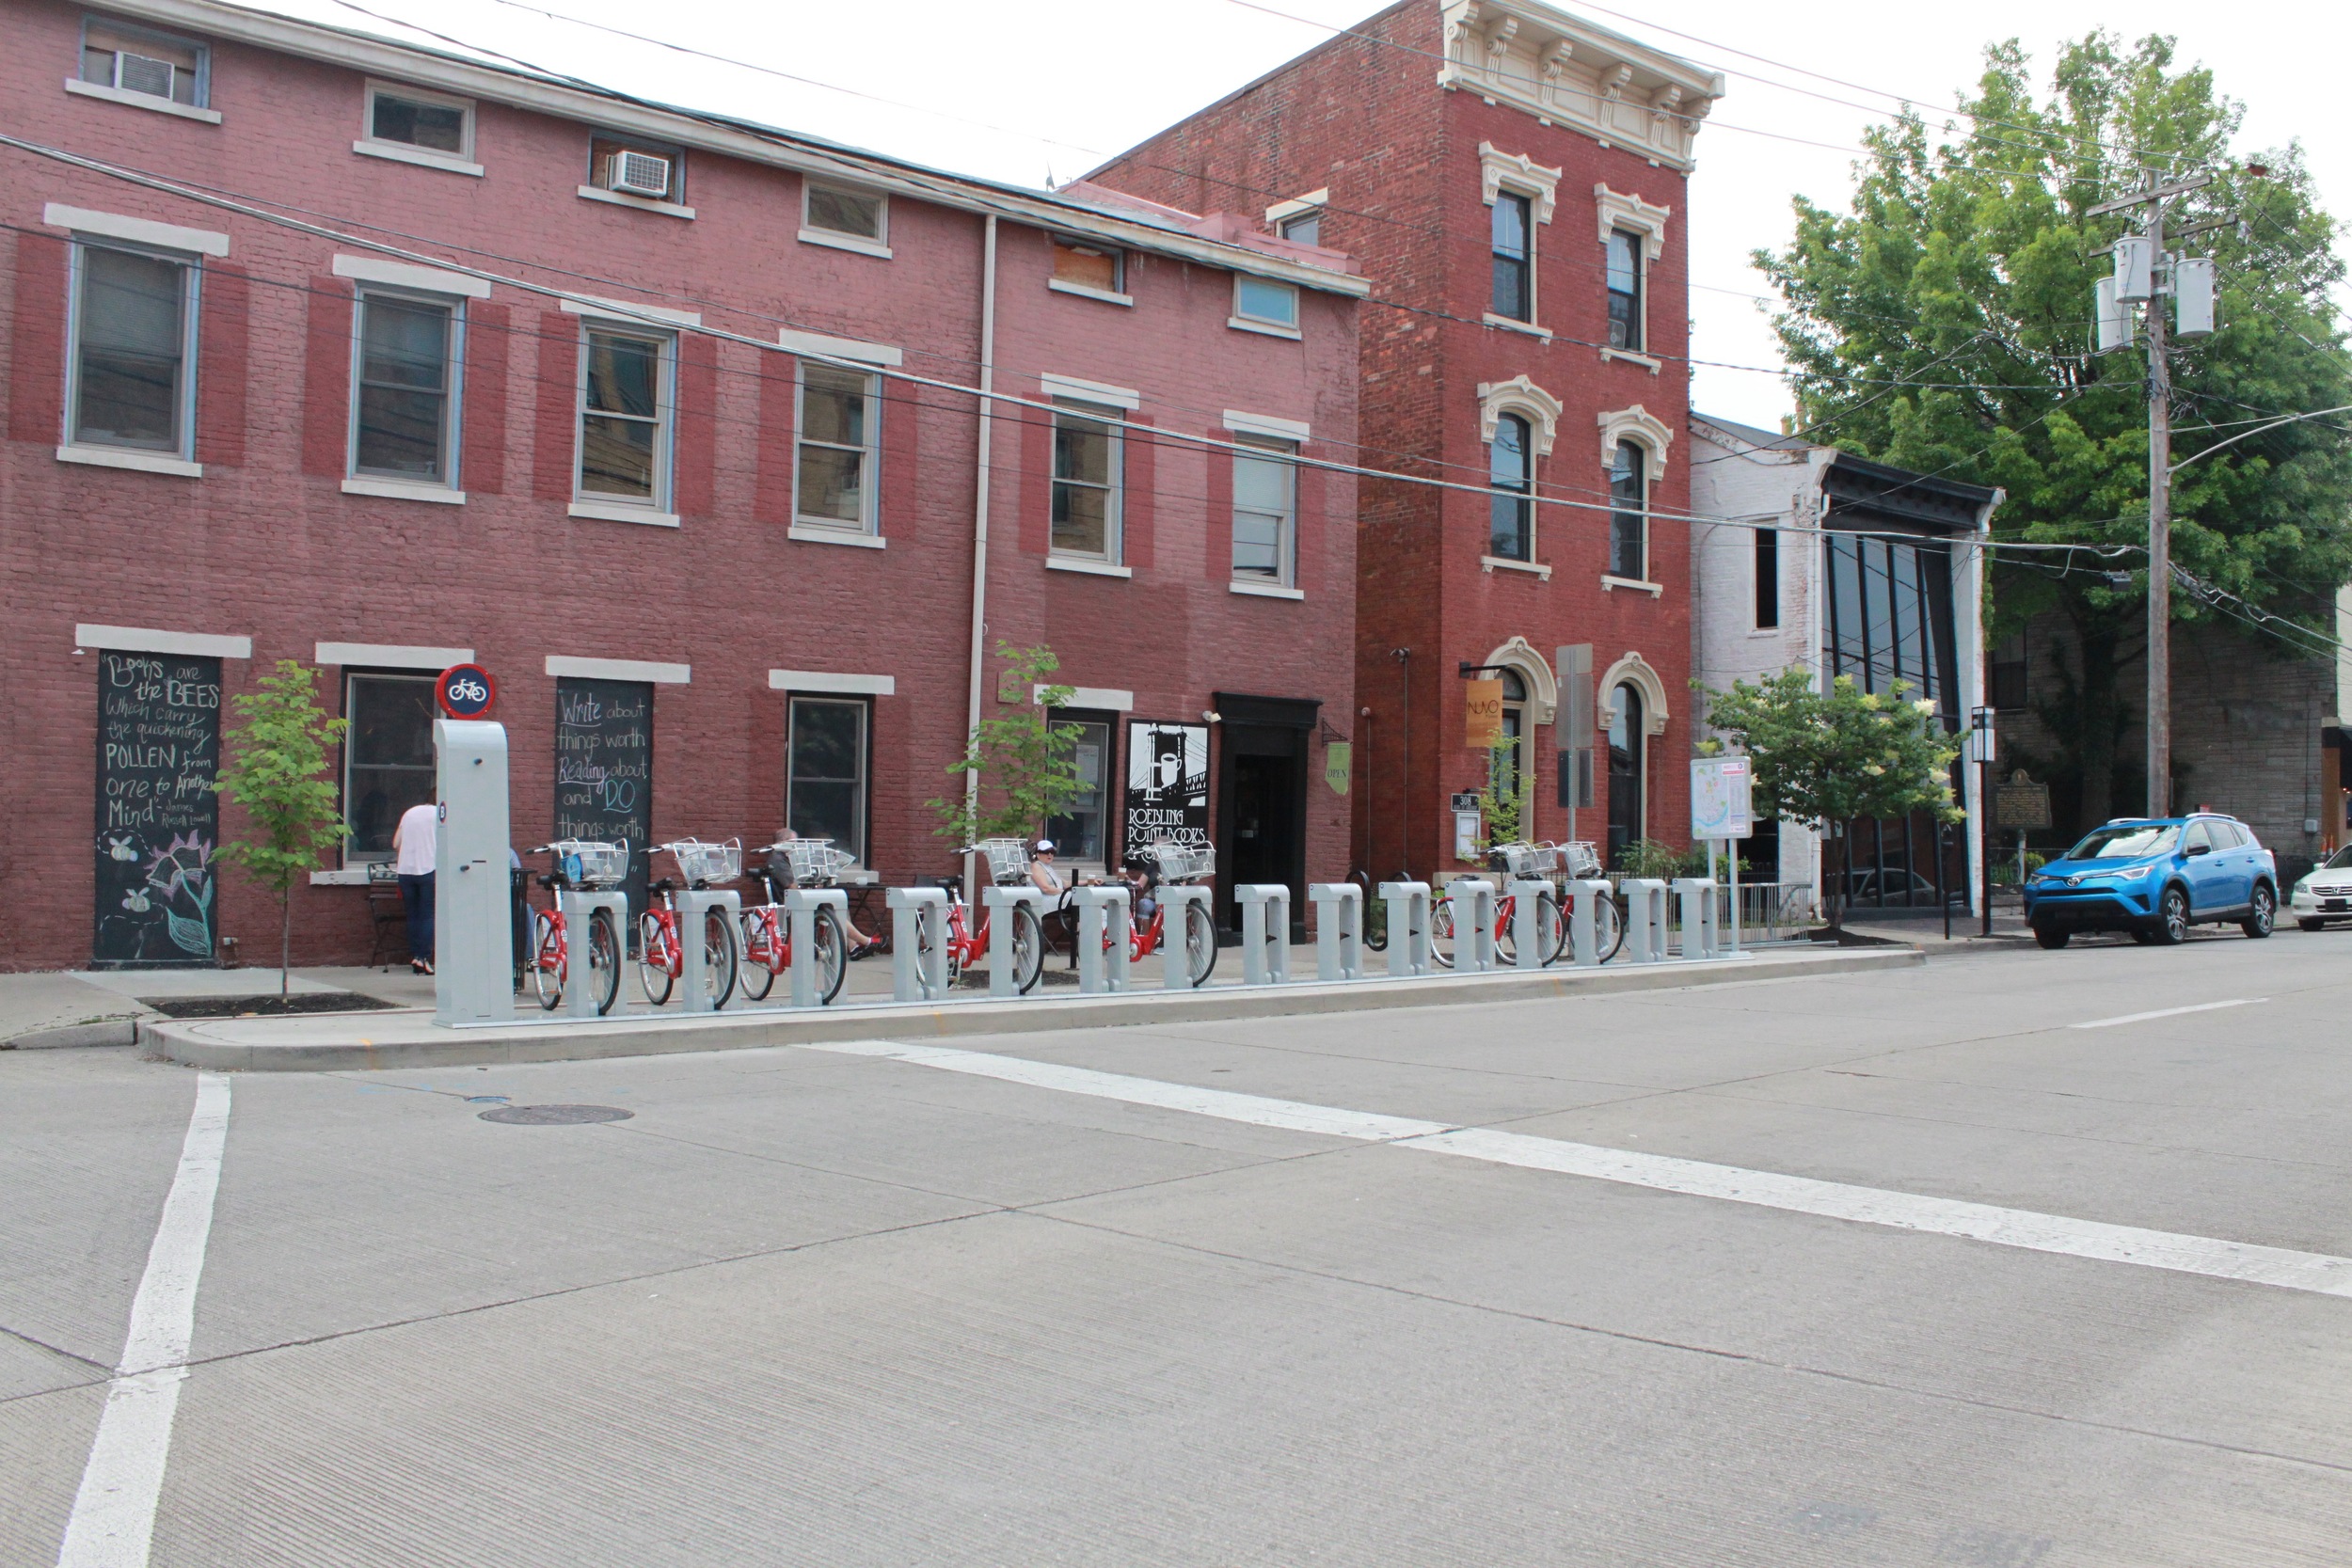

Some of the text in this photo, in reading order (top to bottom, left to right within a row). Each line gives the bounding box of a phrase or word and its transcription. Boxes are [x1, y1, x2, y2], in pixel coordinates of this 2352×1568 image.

[176, 667, 201, 680] are
[134, 679, 220, 708] the BEES
[155, 707, 206, 728] carry
[607, 698, 645, 719] about
[106, 721, 212, 755] the quickening
[557, 726, 645, 761] things worth
[105, 743, 212, 776] POLLEN from
[559, 754, 610, 795] Reading
[1327, 768, 1347, 779] OPEN
[155, 777, 170, 795] to
[563, 779, 636, 809] and DO
[1459, 796, 1472, 806] 308
[557, 813, 644, 843] things worth
[1128, 808, 1184, 830] ROEBLING
[1127, 827, 1205, 844] POINT BOOKS
